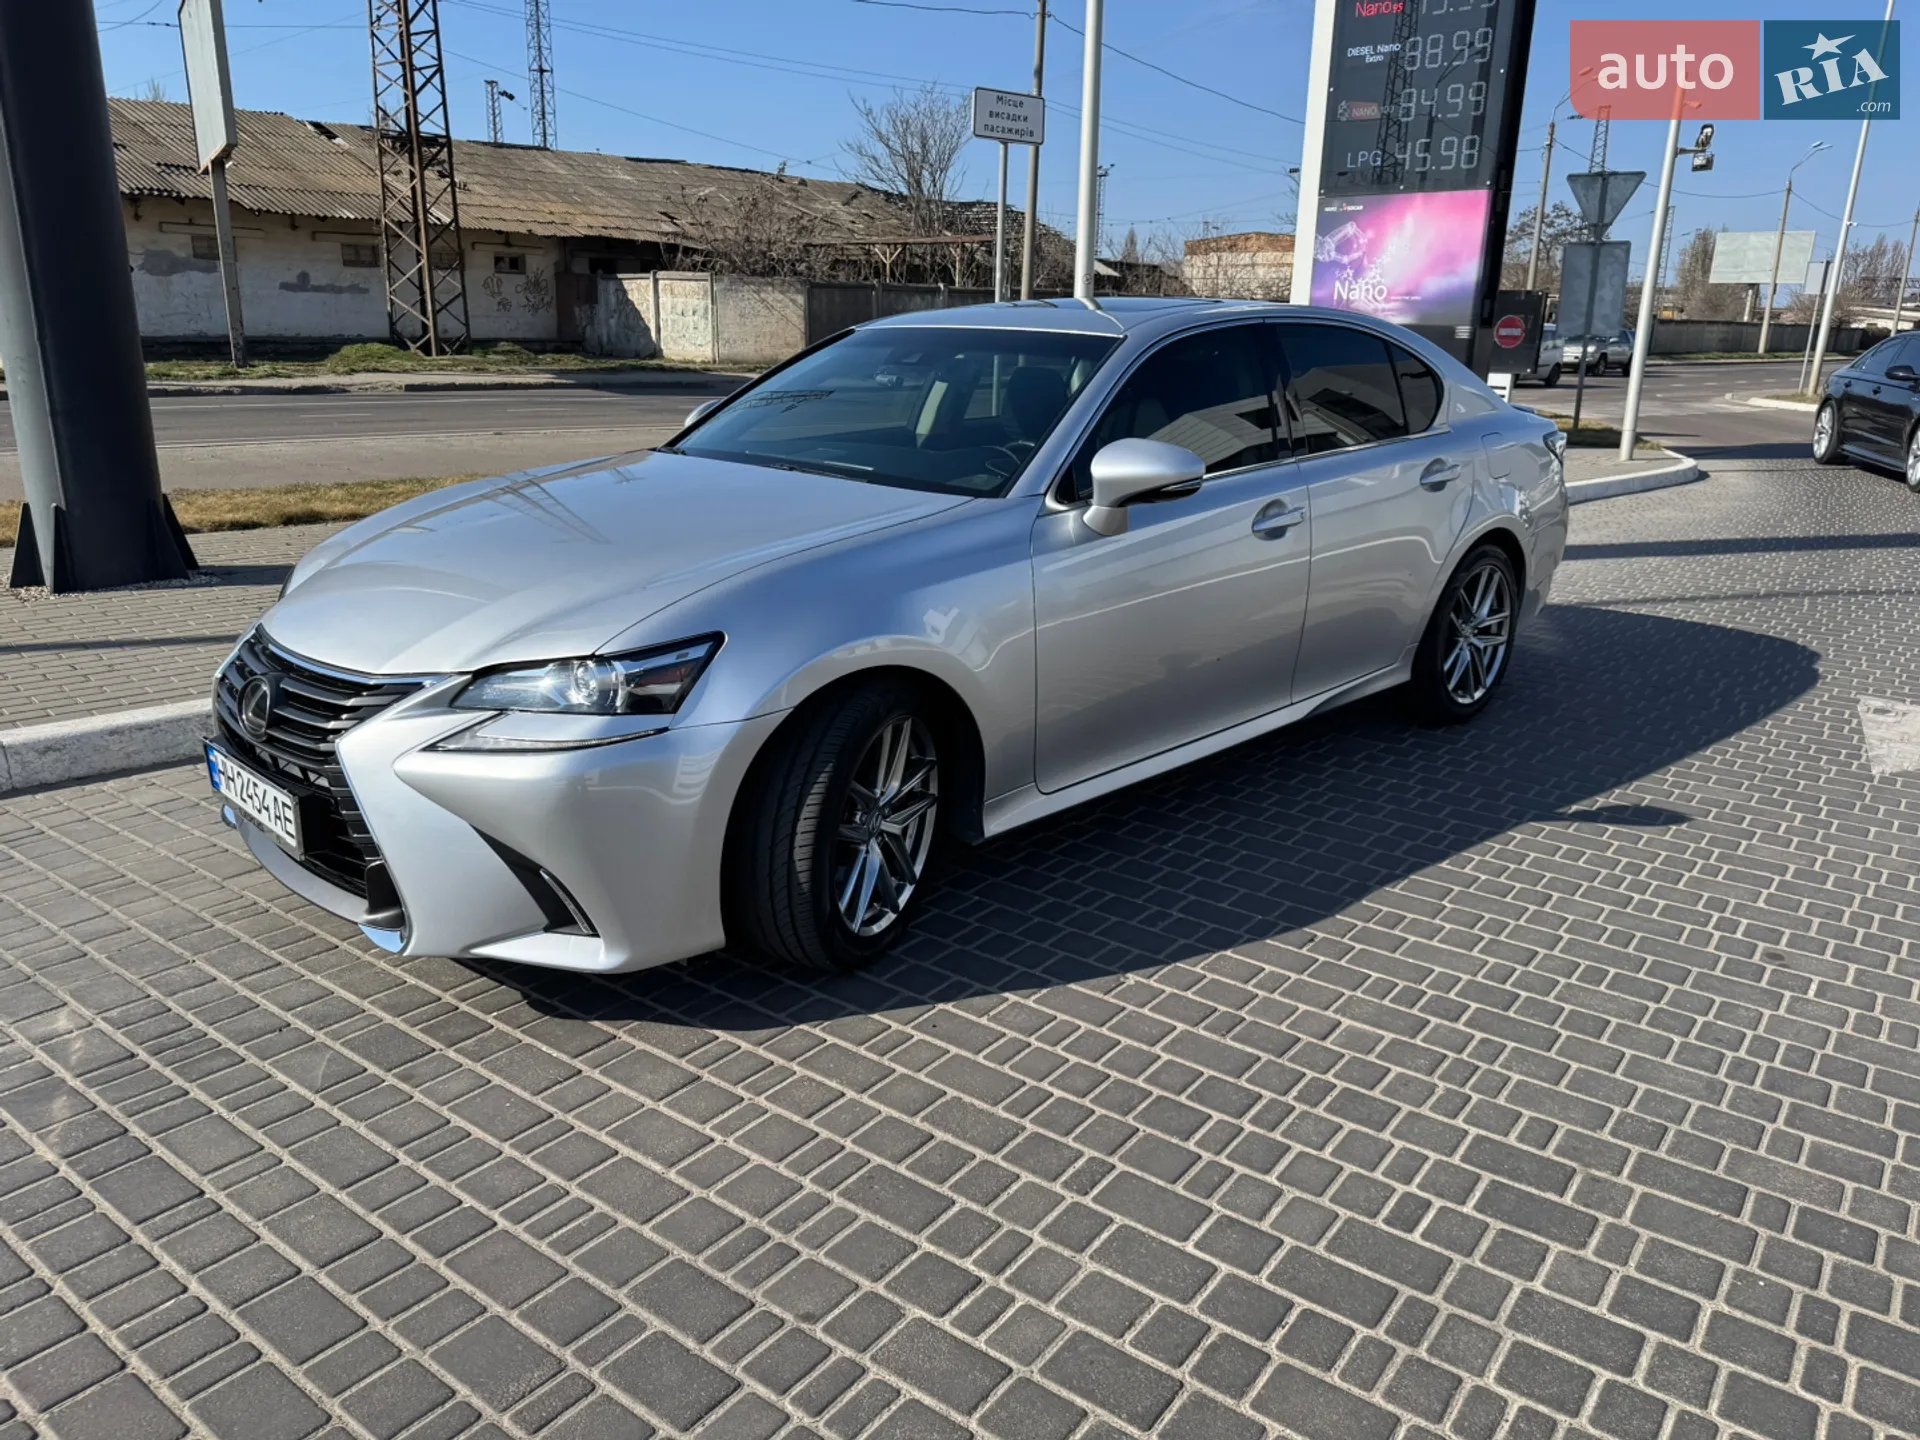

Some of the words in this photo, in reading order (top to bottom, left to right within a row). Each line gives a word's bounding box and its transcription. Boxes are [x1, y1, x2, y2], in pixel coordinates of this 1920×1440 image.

[1355, 1, 1392, 18] Nano
[1347, 46, 1375, 57] DIESEL
[1376, 42, 1401, 53] Nano
[1404, 27, 1492, 71] 88.99
[996, 94, 1024, 108] Місце
[1351, 106, 1377, 118] NANO
[1399, 81, 1487, 122] 84.99
[988, 110, 1028, 123] висадки
[983, 124, 1035, 138] пасажирів
[1347, 150, 1382, 168] LPG
[1394, 134, 1480, 171] 45.98
[1333, 279, 1388, 301] Nano
[272, 795, 296, 840] AE
